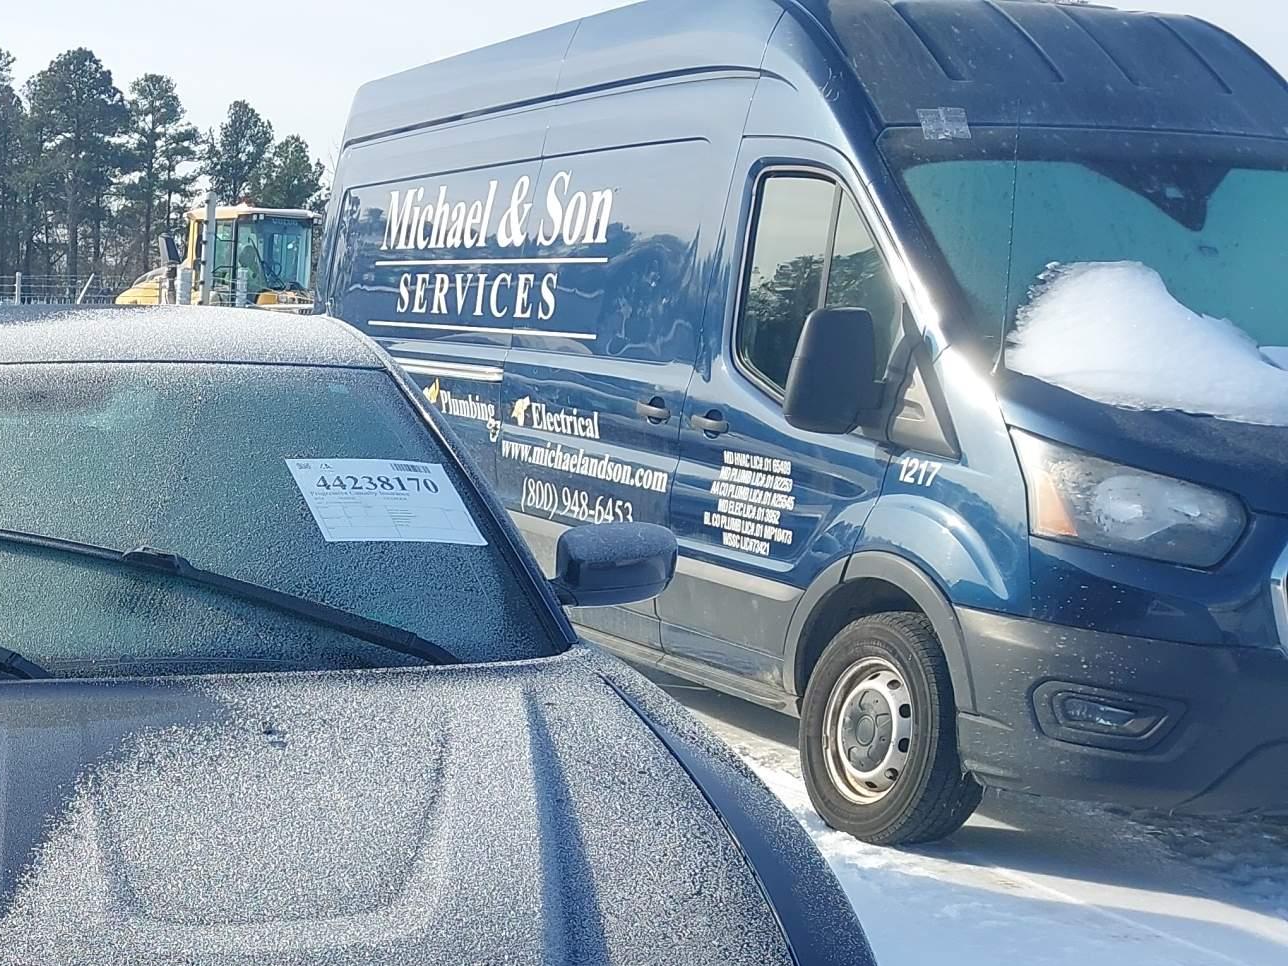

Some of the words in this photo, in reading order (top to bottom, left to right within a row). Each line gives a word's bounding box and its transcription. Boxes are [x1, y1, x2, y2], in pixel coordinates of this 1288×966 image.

[380, 179, 498, 250] Michael
[496, 175, 533, 248] &
[536, 169, 613, 247] Son
[396, 272, 558, 320] SERVICES
[439, 389, 496, 430] Plumbing
[531, 402, 601, 440] Electrical
[315, 475, 439, 494] 44238170
[501, 439, 669, 493] www.michaelandson.com
[898, 457, 944, 487] 1217
[521, 476, 559, 520] (800)
[560, 487, 634, 525] 948-6453
[719, 482, 728, 497] CO
[712, 513, 720, 528] CO
[723, 532, 740, 548] WSSC
